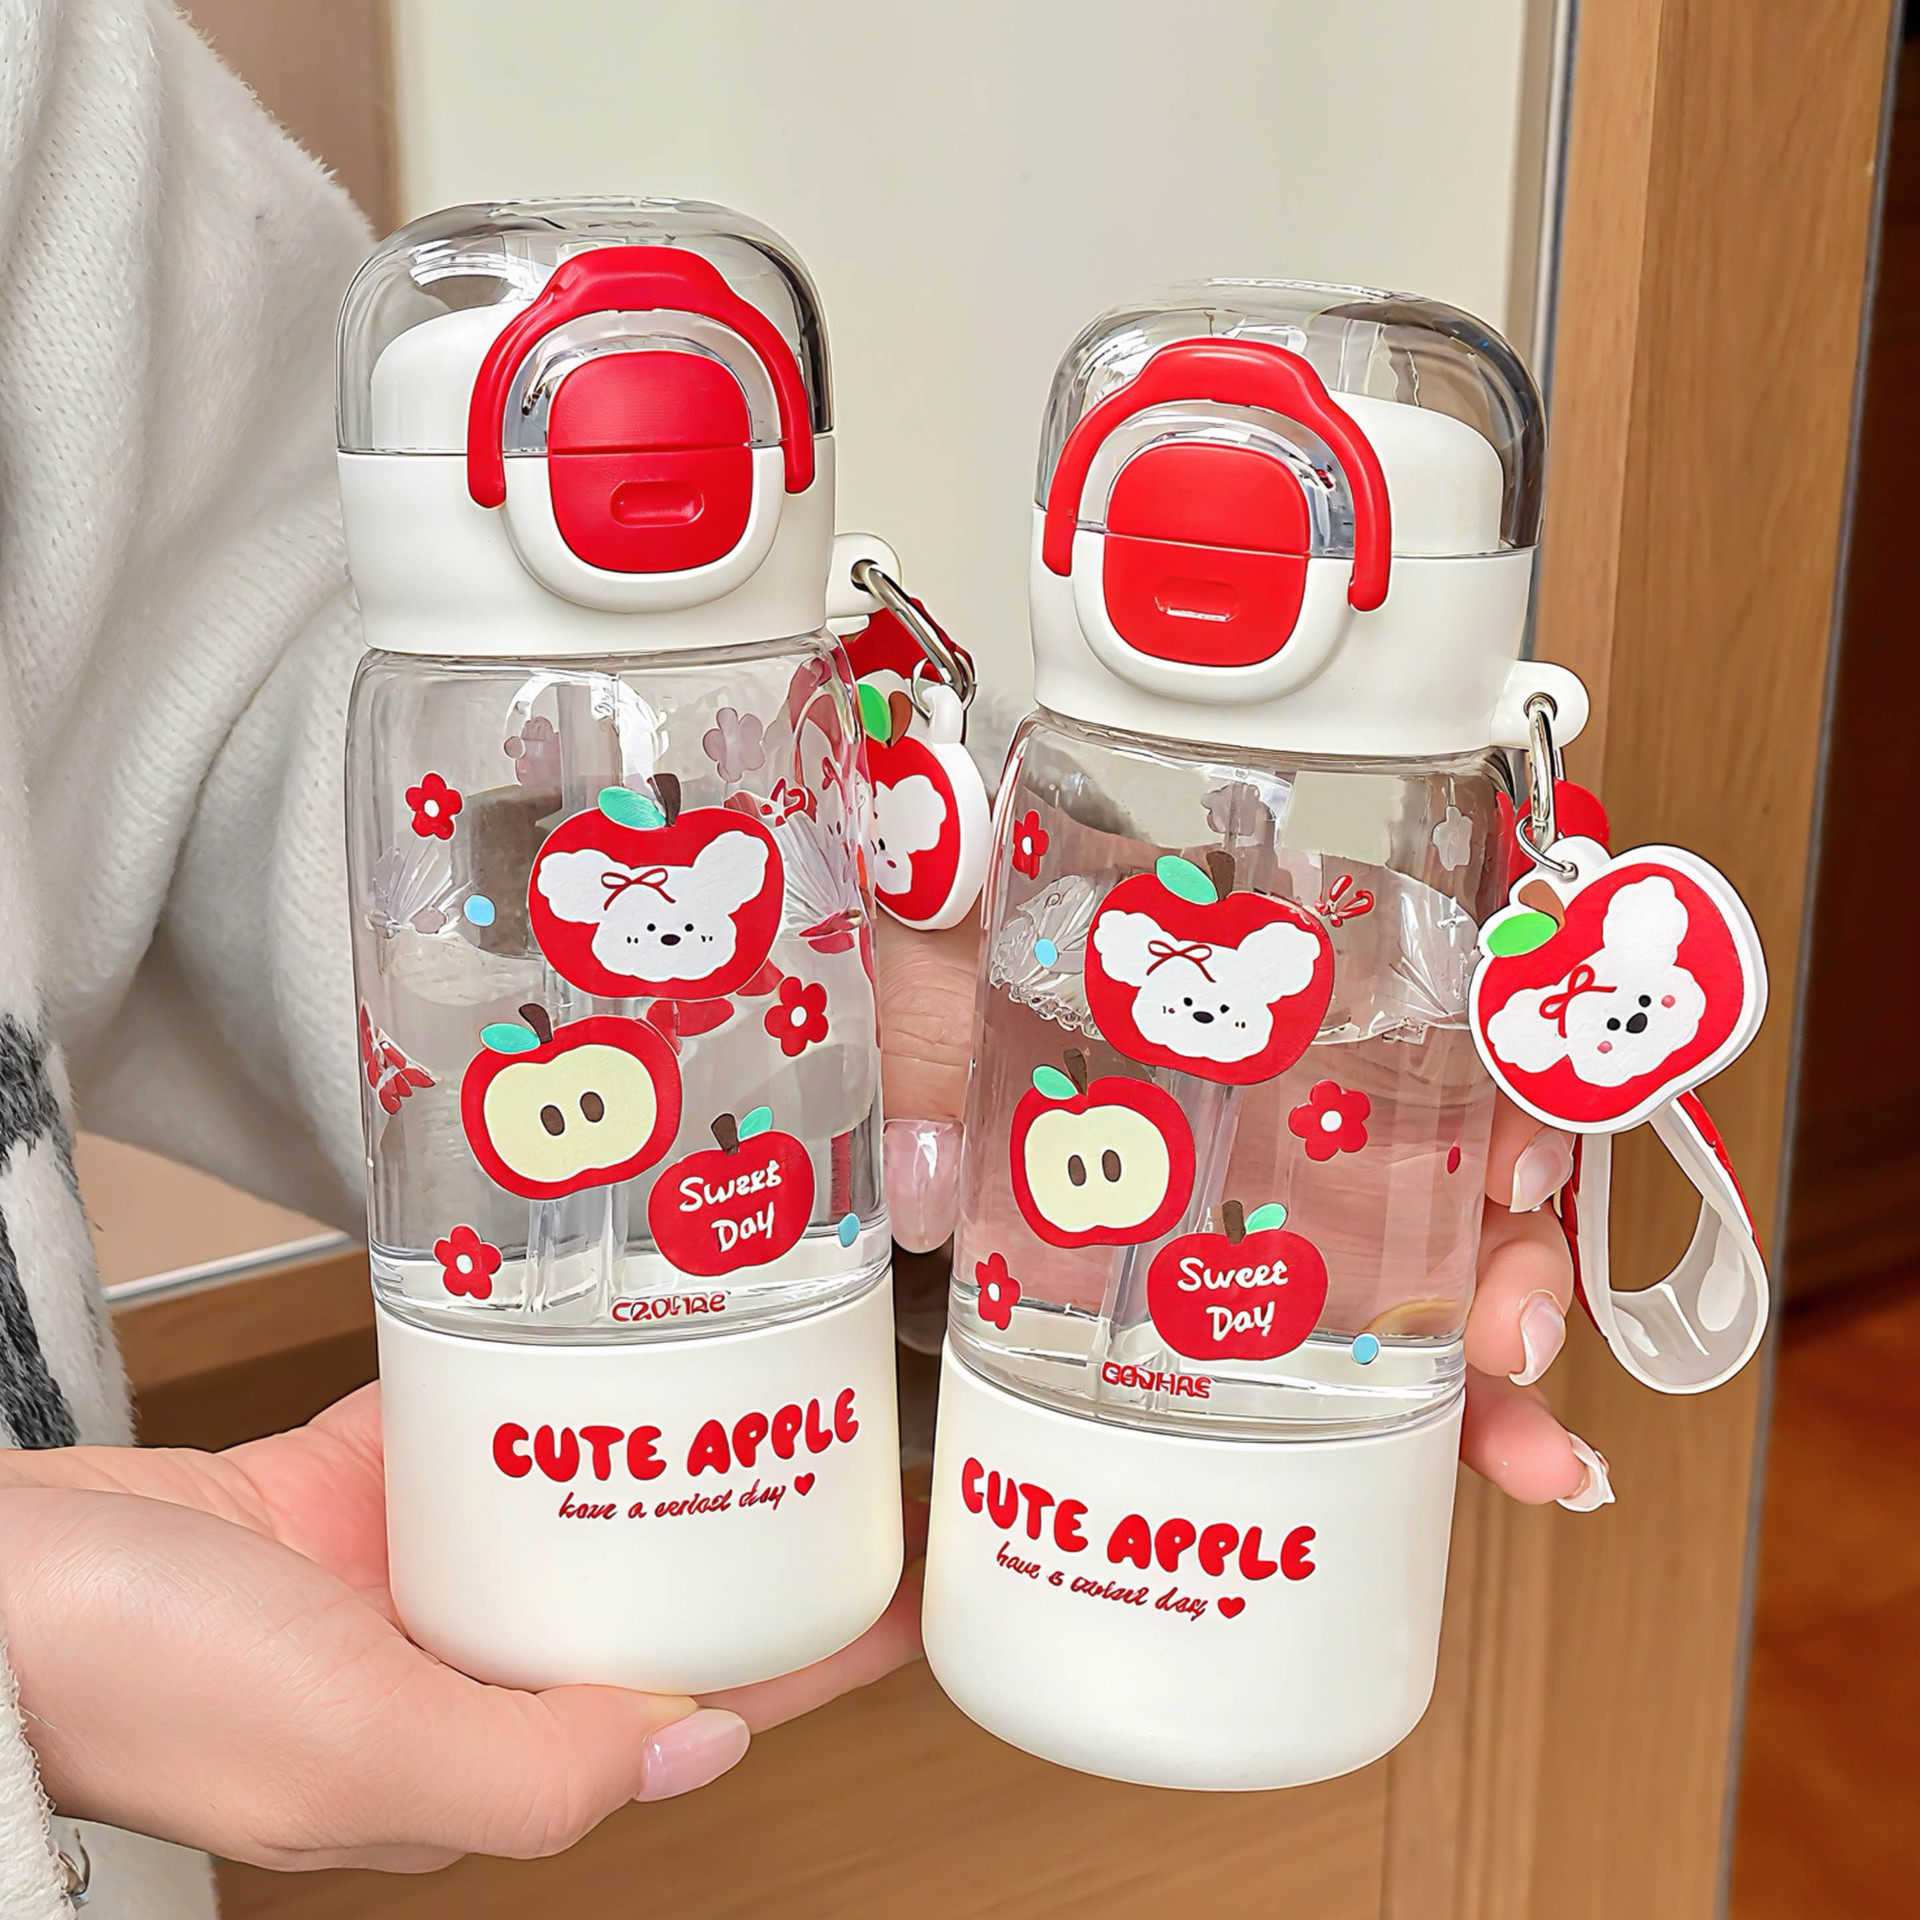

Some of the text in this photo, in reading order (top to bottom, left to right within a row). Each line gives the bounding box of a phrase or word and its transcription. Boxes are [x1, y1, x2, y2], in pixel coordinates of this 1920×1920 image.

[678, 1159, 783, 1213] Sweet
[710, 1201, 776, 1252] Day
[1176, 1257, 1289, 1292] Sweet
[1205, 1300, 1276, 1342] Day
[492, 1387, 860, 1483] CUTE APPLE
[961, 1456, 1317, 1581] CUTE APPLE
